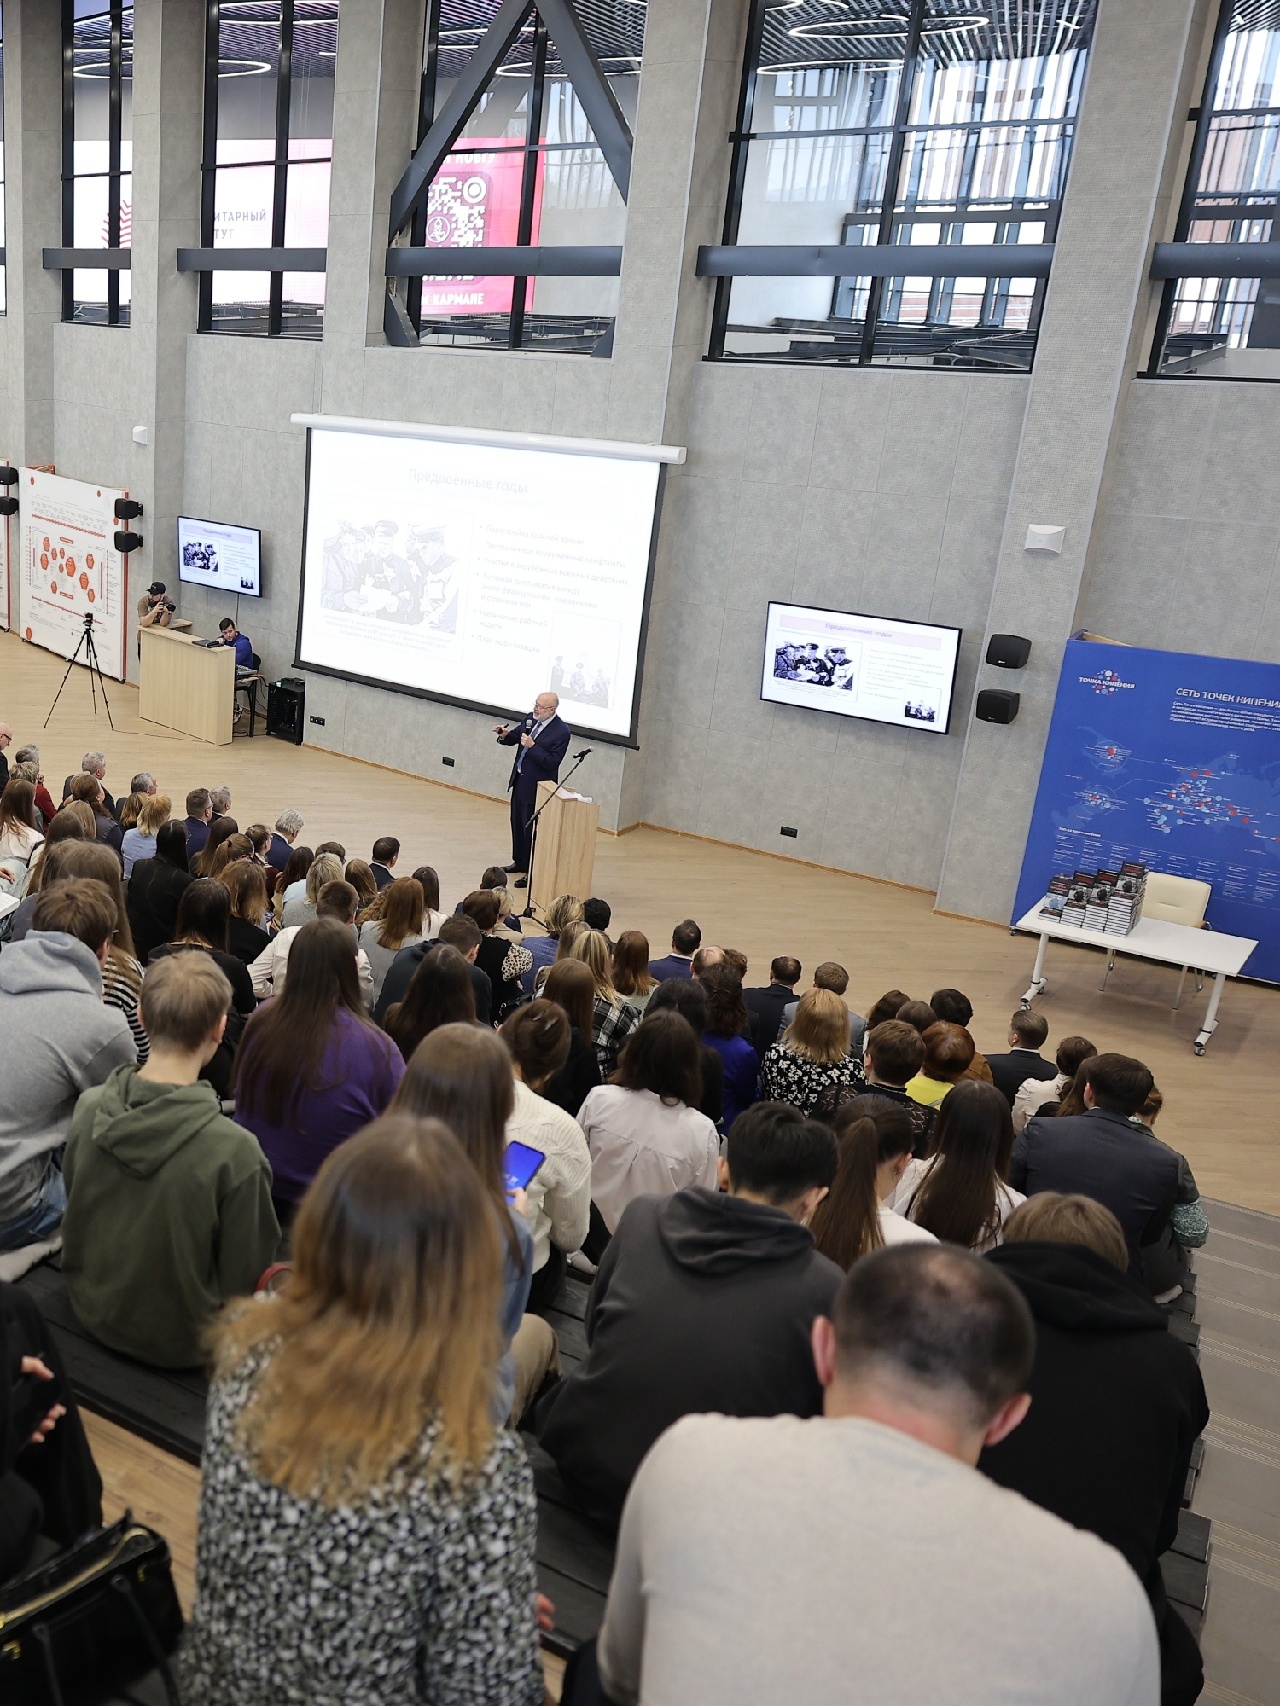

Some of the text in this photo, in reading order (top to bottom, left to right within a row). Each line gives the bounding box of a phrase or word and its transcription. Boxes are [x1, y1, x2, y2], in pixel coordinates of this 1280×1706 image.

[433, 292, 485, 306] КАРМАНЕ
[408, 467, 529, 495] Предвоенные годы
[1078, 676, 1102, 685] ТОЧКА
[1176, 687, 1280, 708] СЕТЬ ТОЧЕК КИПЕНИ
